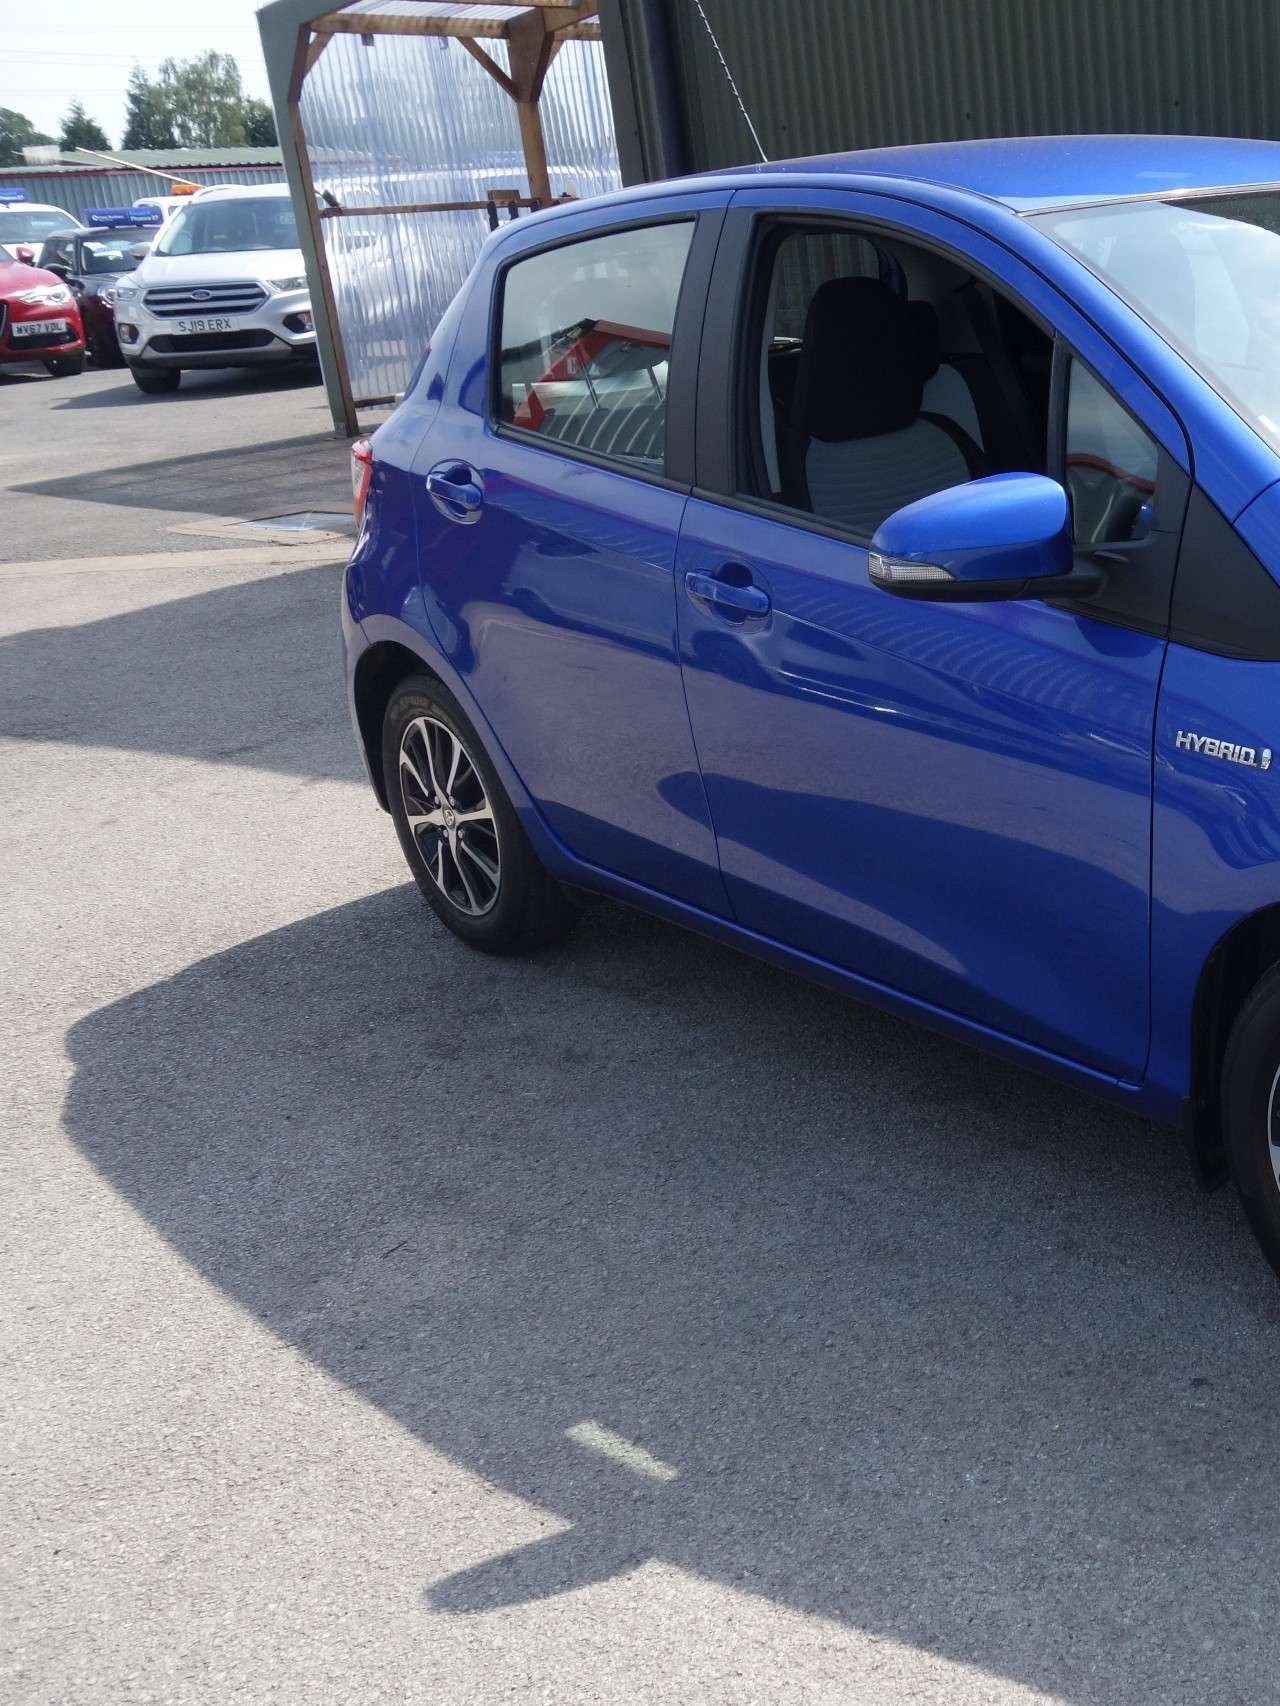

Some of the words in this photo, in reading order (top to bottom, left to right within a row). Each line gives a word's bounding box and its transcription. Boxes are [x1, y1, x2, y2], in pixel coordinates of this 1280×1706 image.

[178, 320, 205, 332] SJ19
[207, 318, 232, 331] ERX
[1175, 730, 1257, 767] HYBRID
